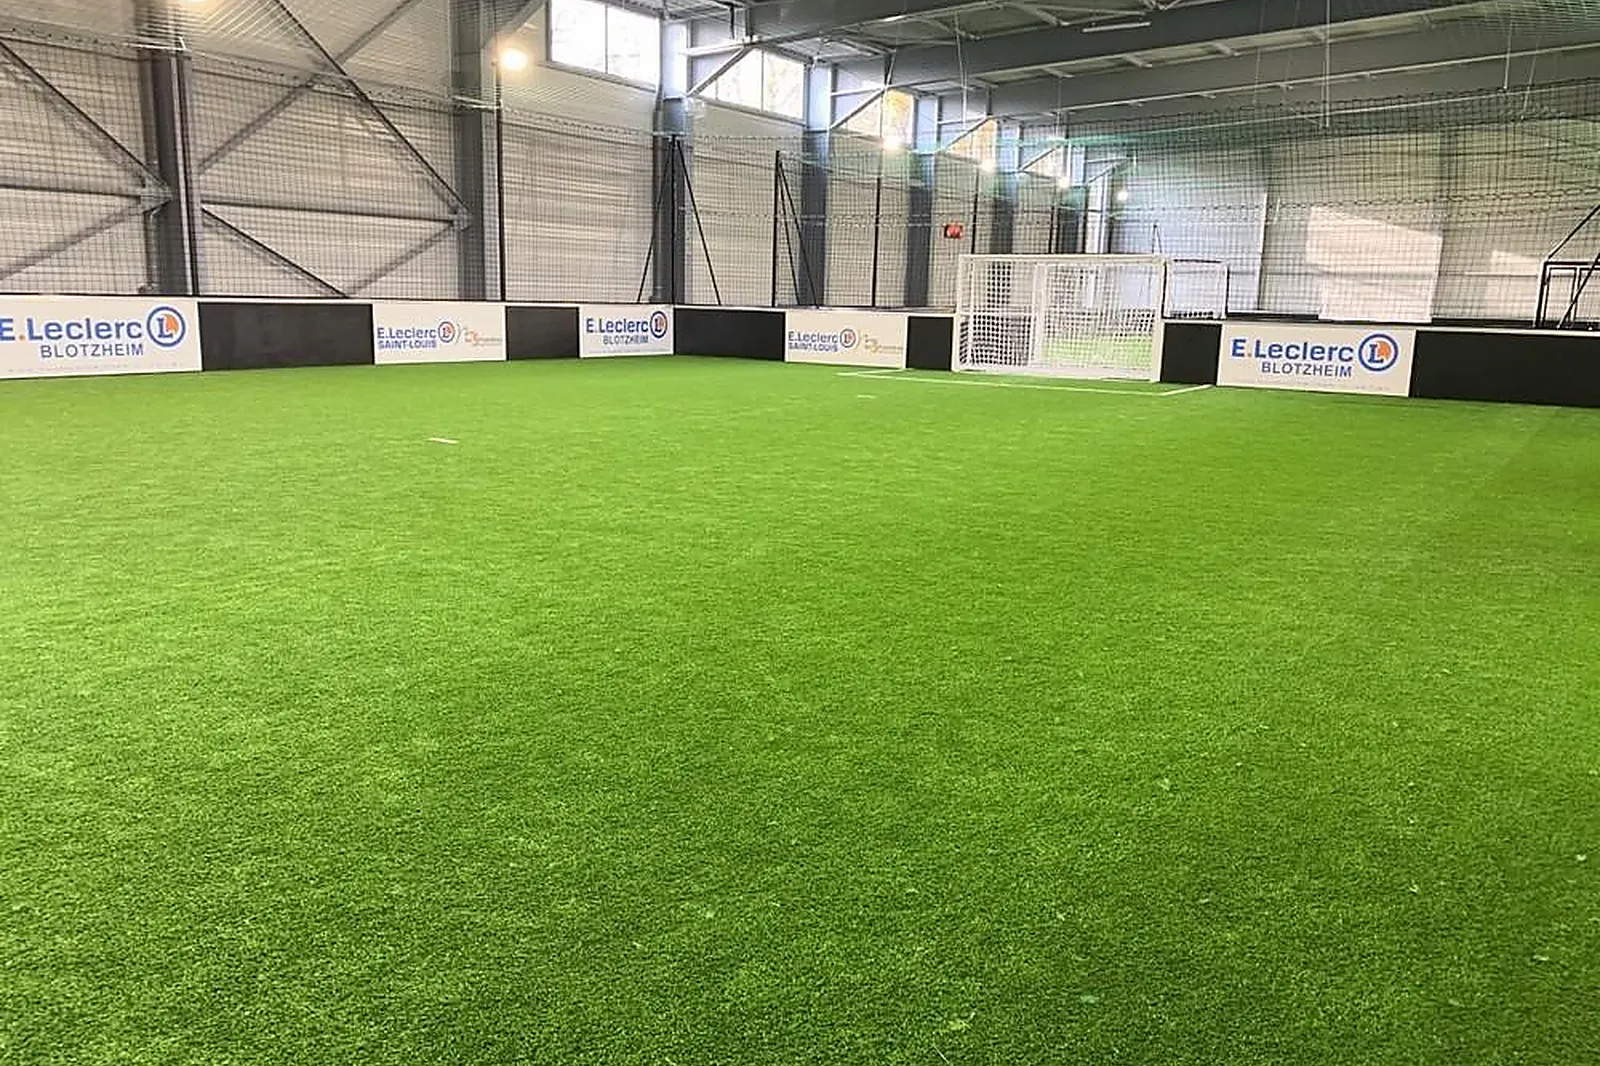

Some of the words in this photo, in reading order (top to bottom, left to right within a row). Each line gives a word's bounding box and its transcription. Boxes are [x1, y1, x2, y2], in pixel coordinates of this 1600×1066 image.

[0, 317, 142, 341] E.Leclerc
[377, 327, 437, 339] E.Leclerc
[41, 343, 143, 358] BLOTZHEIM
[1231, 338, 1354, 362] E.Leclerc
[1261, 362, 1352, 377] BLOTZHEIM
